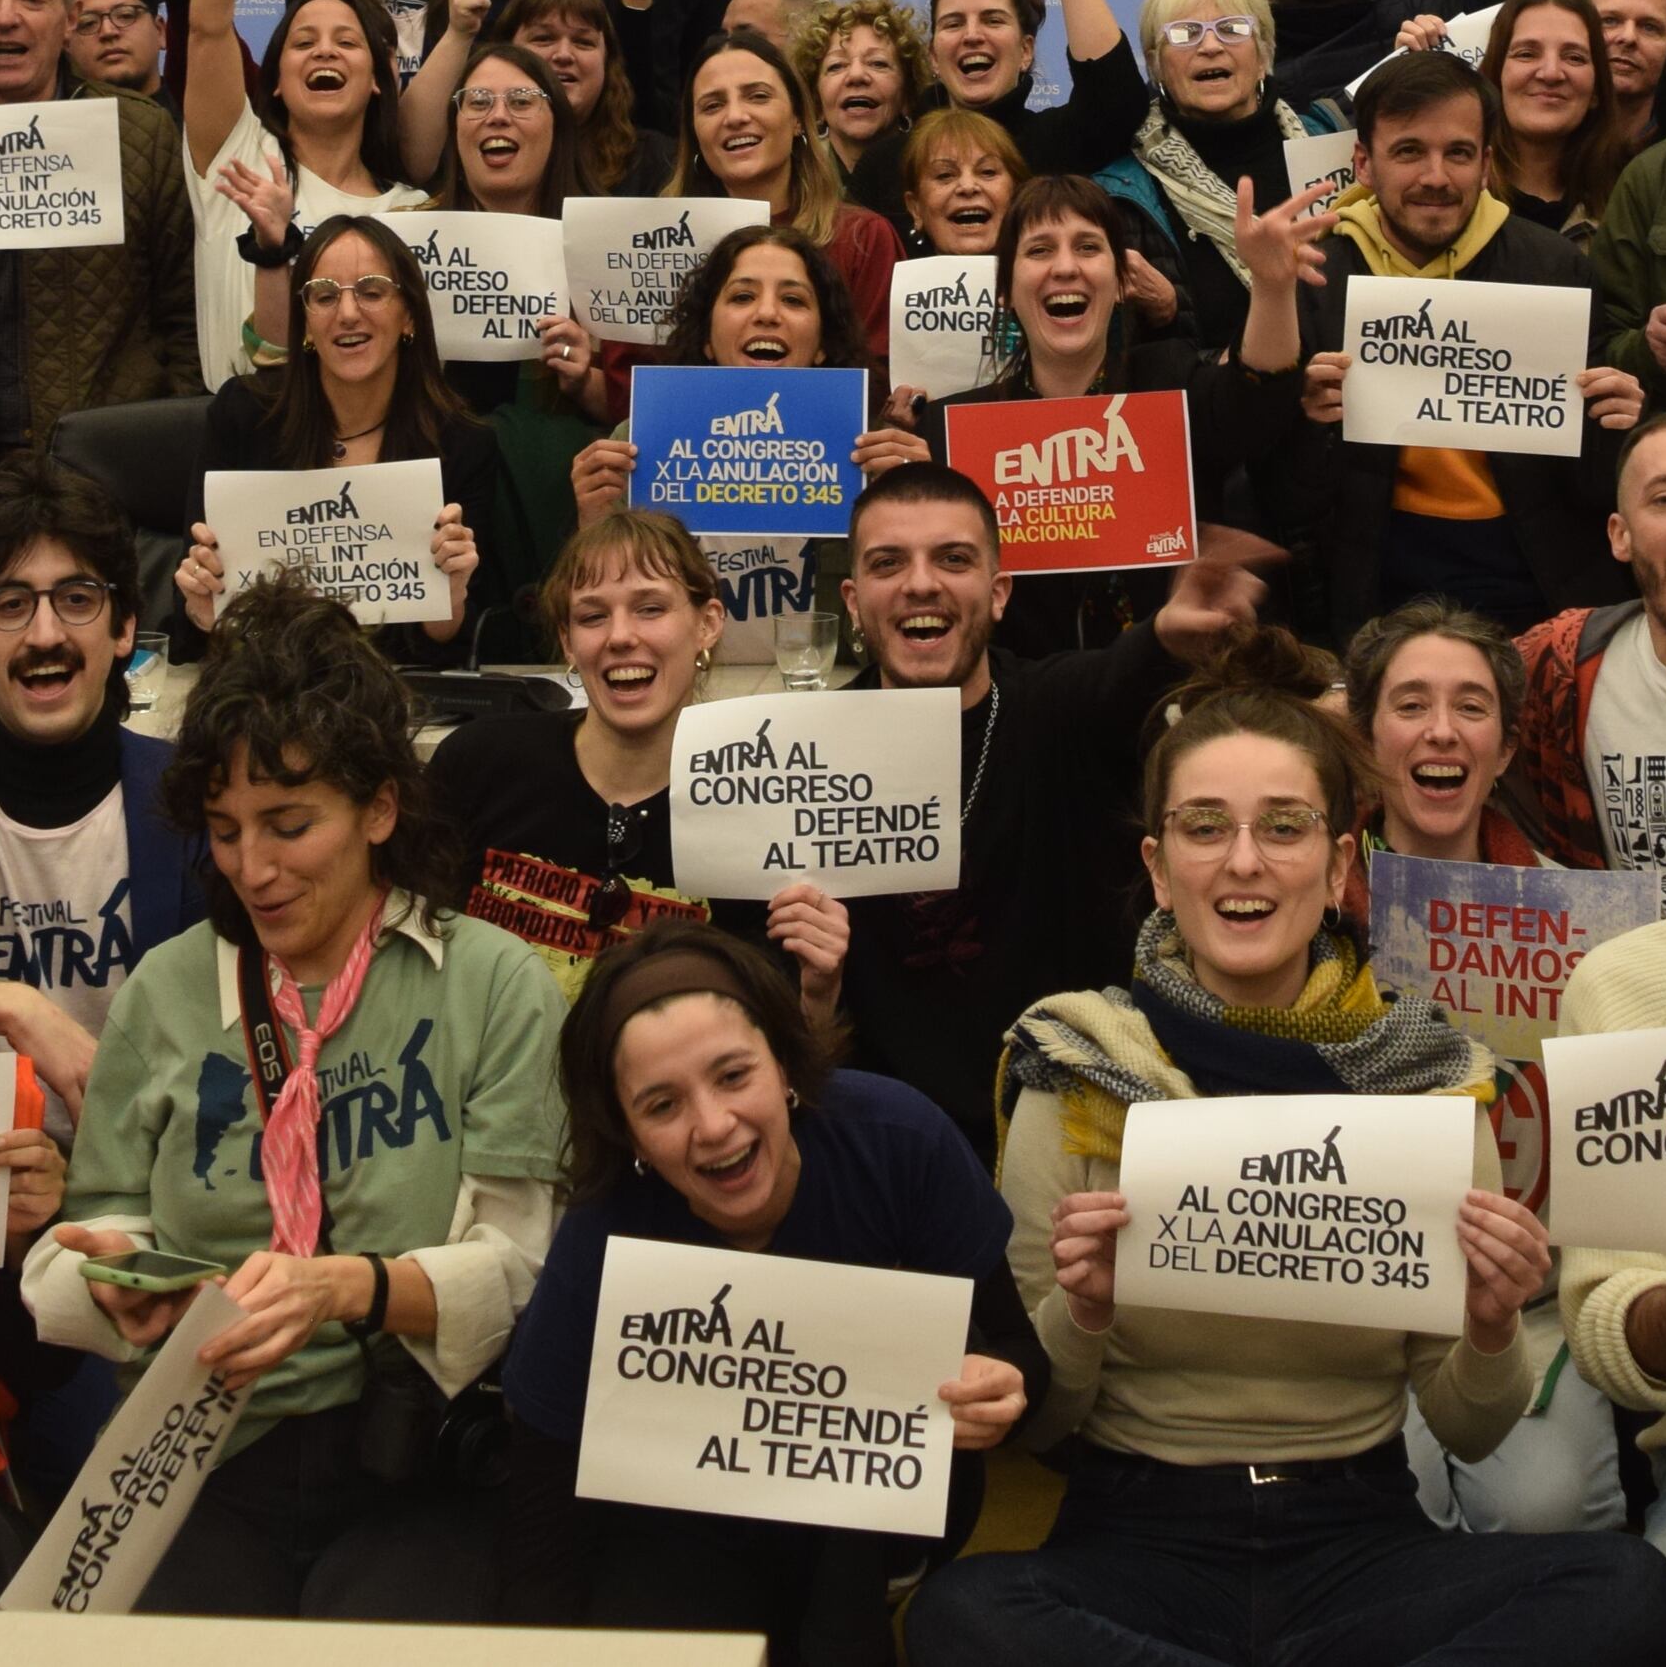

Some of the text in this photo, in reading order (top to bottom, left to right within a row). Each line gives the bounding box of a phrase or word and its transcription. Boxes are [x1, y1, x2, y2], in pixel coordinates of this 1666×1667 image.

[1361, 298, 1476, 344] ENTRÁ AL
[1361, 341, 1511, 372] CONGRESO
[1445, 372, 1567, 402] DEFENDÉ
[711, 392, 784, 437] ENTRÁ
[1417, 398, 1564, 428] AL TEATRO
[669, 439, 824, 460] AL CONGRESO
[994, 394, 1145, 486] ENTRÁ
[656, 455, 837, 483] X LA ANULACIÓN
[651, 482, 843, 504] DEL DECRETO 345
[995, 485, 1114, 508] A DEFENDER
[996, 504, 1116, 526] LA CULTURA
[998, 522, 1100, 544] NACIONAL
[1146, 526, 1187, 553] ENTRÁ
[690, 718, 828, 775] ENTRÁ AL
[690, 774, 873, 806] CONGRESO
[795, 796, 940, 836] DEFENDÉ
[763, 835, 939, 870] AL TEATRO
[490, 853, 580, 905] PATRICIO
[1429, 899, 1586, 946] DEFEN-
[1432, 976, 1564, 1021] AL INT
[254, 1022, 283, 1083] EOS
[1240, 1126, 1347, 1185] ENTRÁ
[1177, 1185, 1406, 1228] AL CONGRESO
[1158, 1214, 1423, 1258] X LA ANULACIÓN
[1149, 1243, 1429, 1289] DEL DECRETO 345
[621, 1284, 795, 1355] ENTRÁ AL
[618, 1346, 847, 1398] CONGRESO
[743, 1398, 929, 1448] DEFENDÉ
[696, 1436, 922, 1490] AL TEATRO
